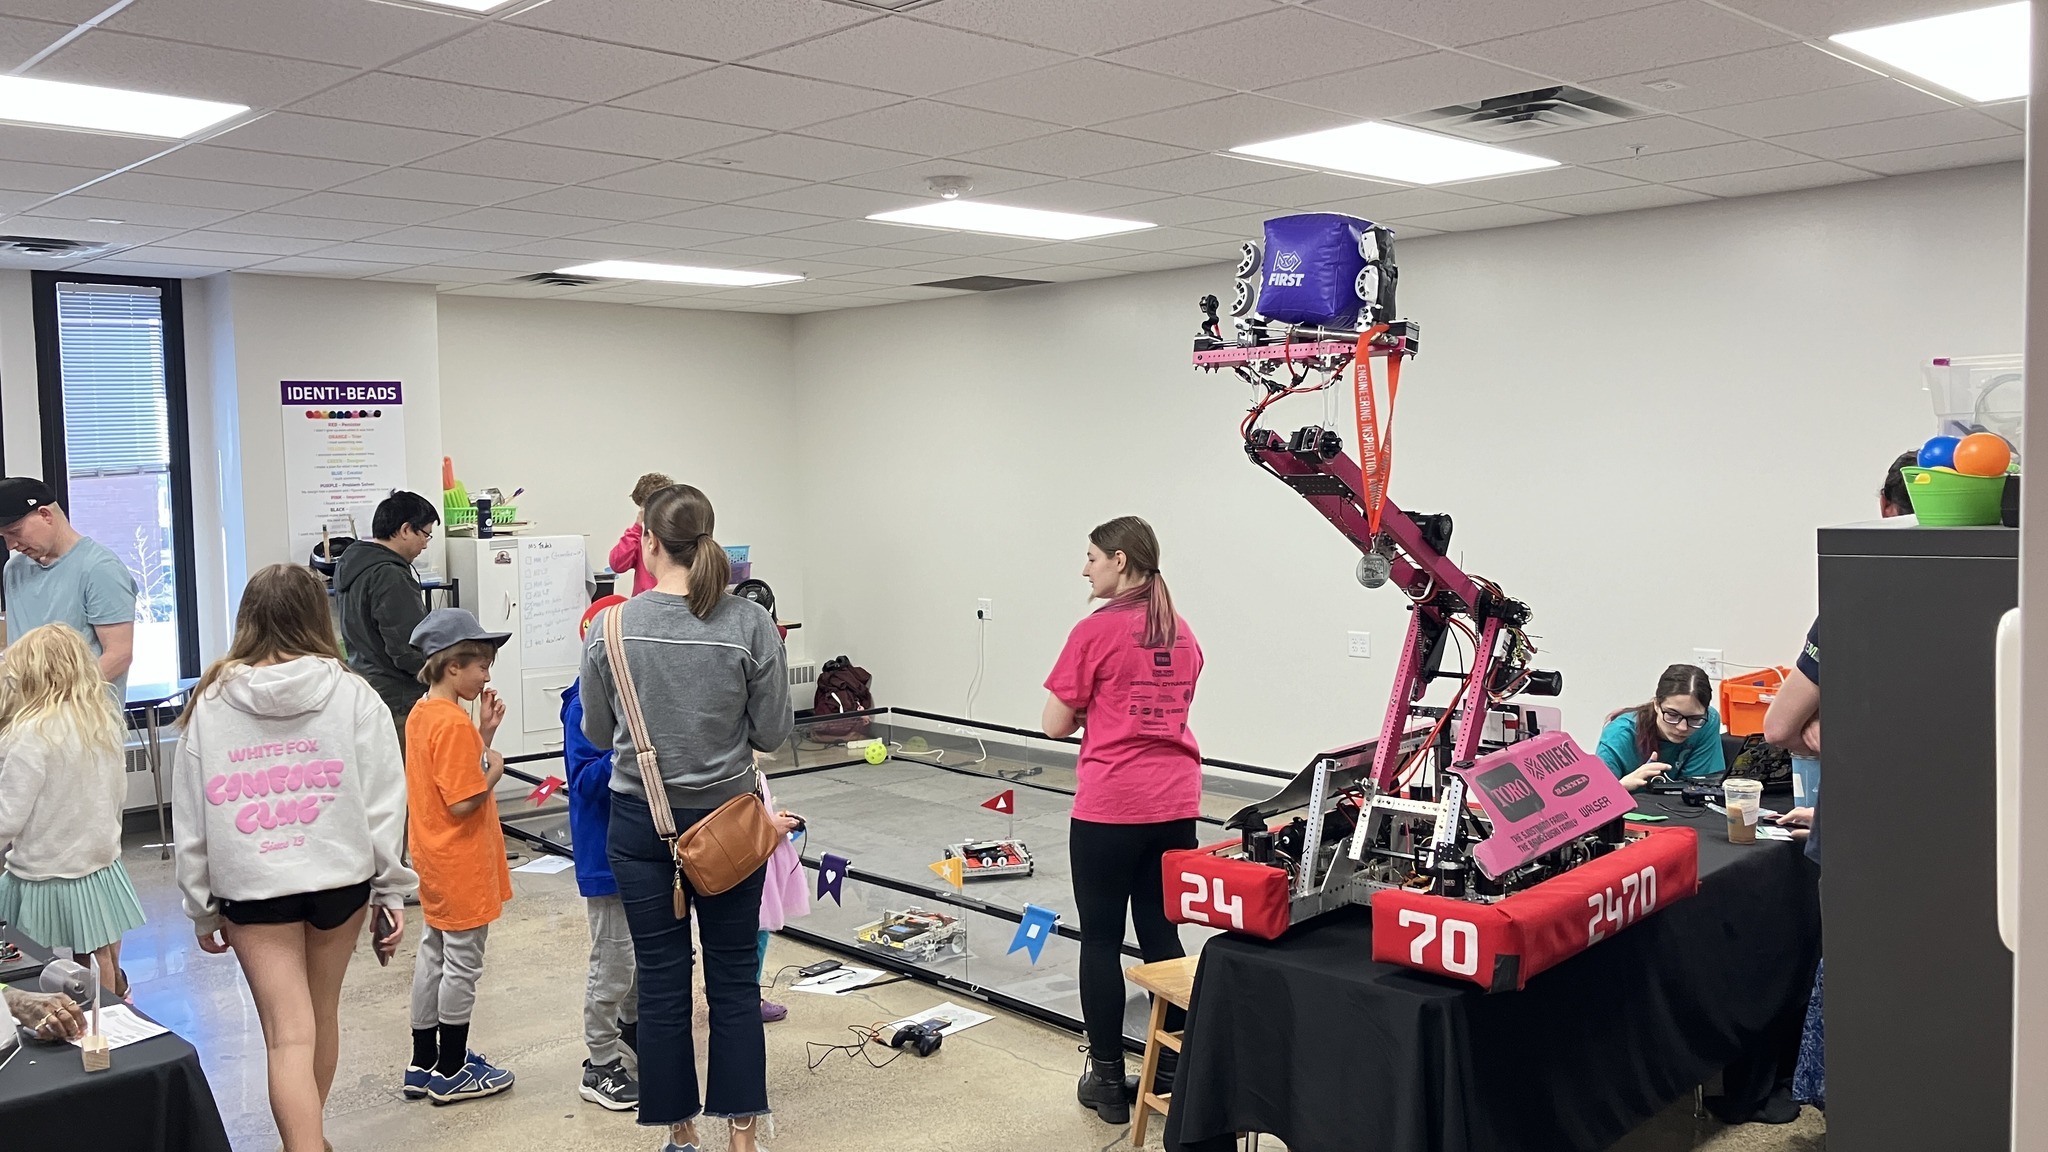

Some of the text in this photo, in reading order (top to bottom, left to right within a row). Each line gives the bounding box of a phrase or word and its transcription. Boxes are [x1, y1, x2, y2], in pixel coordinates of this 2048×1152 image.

[1268, 273, 1304, 286] FIRST
[287, 386, 397, 400] IDENTI-BEADS
[1357, 364, 1371, 421] ENGINEERING
[227, 739, 319, 762] WHITE FOX
[1536, 741, 1580, 774] AVIENT
[205, 759, 345, 806] COMFORT
[1490, 778, 1531, 807] TORO
[1555, 776, 1588, 795] BANNER
[1578, 796, 1612, 818] WALSER
[1510, 833, 1523, 844] THE
[1517, 842, 1531, 853] THE
[1180, 871, 1244, 930] 24
[1587, 865, 1657, 947] 2470
[1399, 908, 1479, 976] 70
